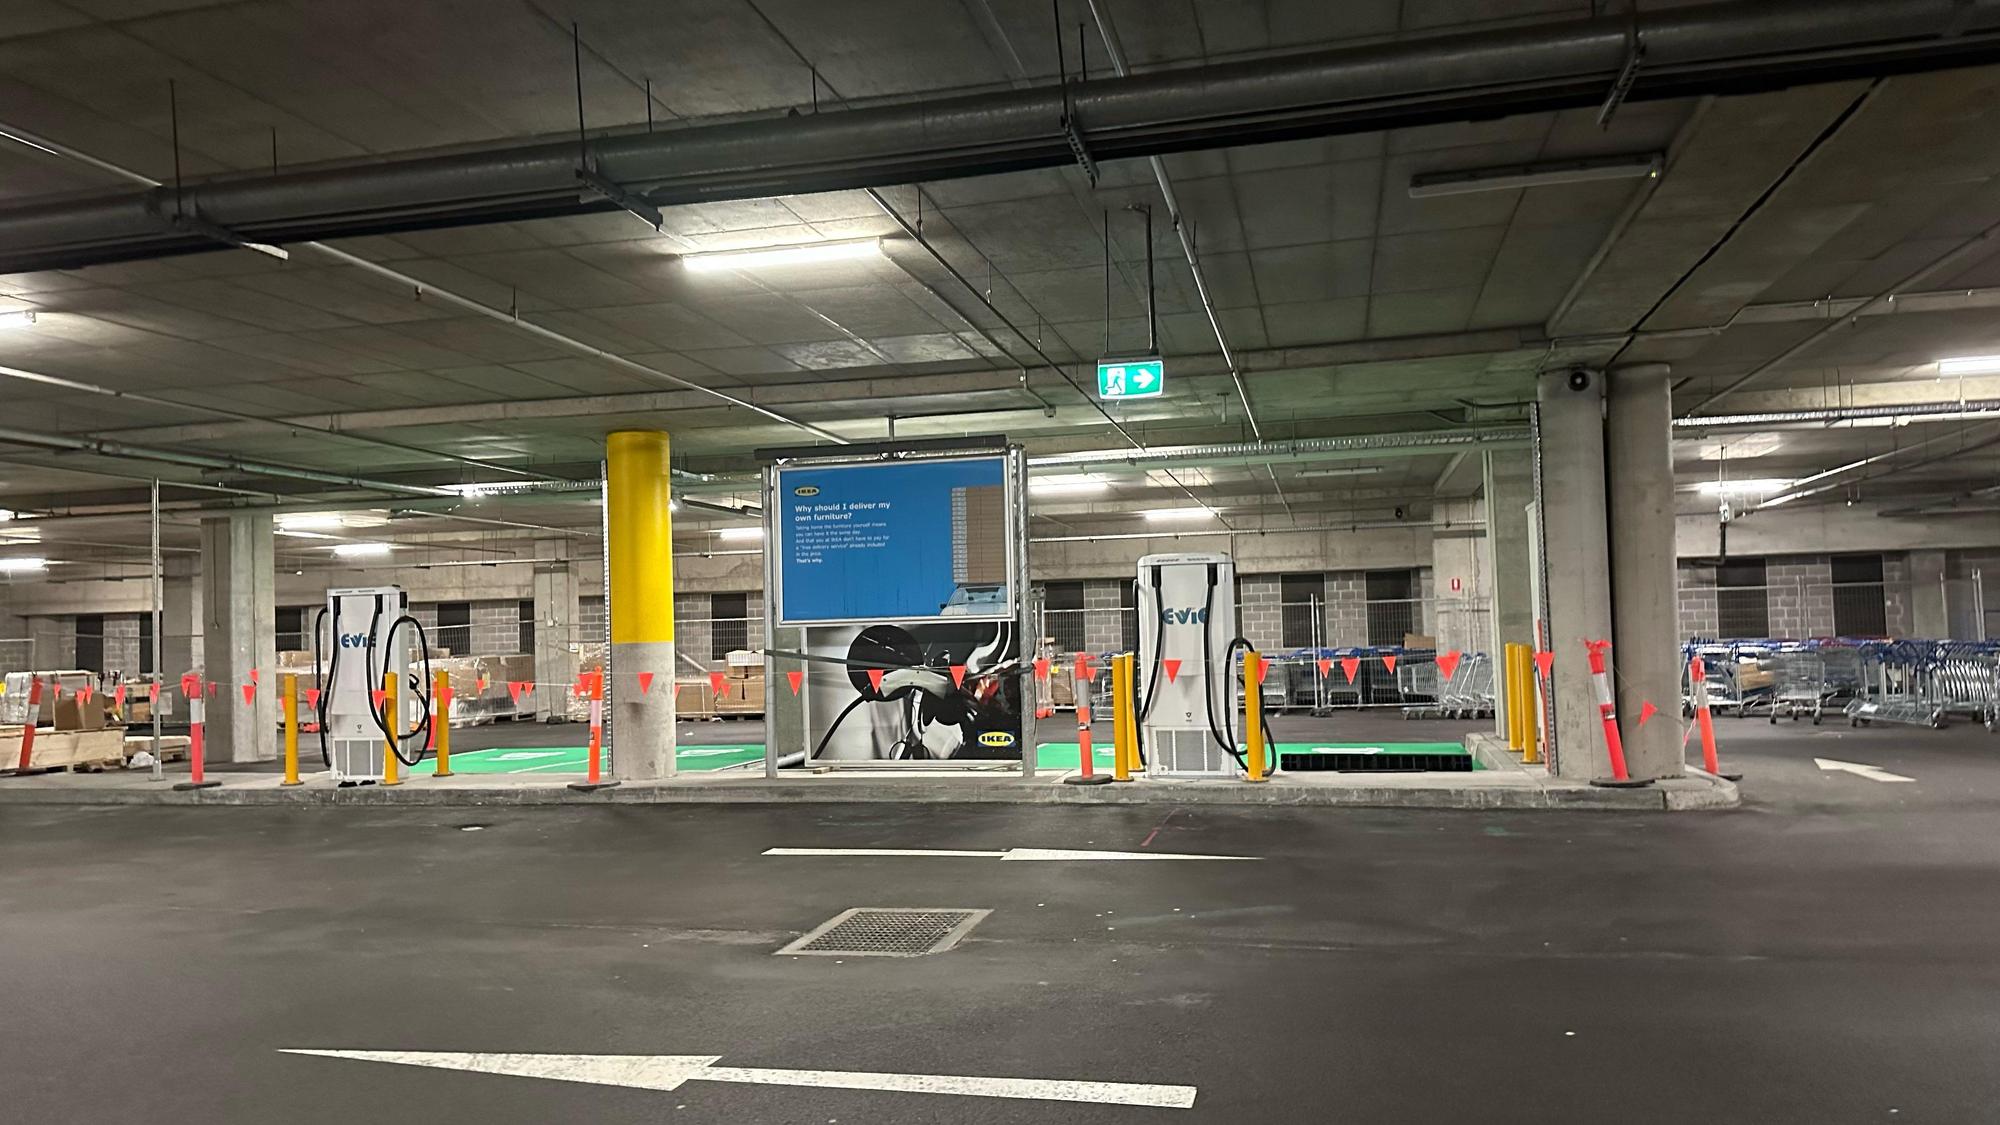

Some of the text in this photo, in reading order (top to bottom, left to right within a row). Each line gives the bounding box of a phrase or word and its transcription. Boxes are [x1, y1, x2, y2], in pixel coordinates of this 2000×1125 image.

[795, 505, 812, 513] Why
[814, 503, 840, 512] should
[849, 502, 875, 510] deliver
[878, 501, 891, 509] my
[795, 512, 852, 522] own furniture?
[982, 735, 1011, 743] IKEA
